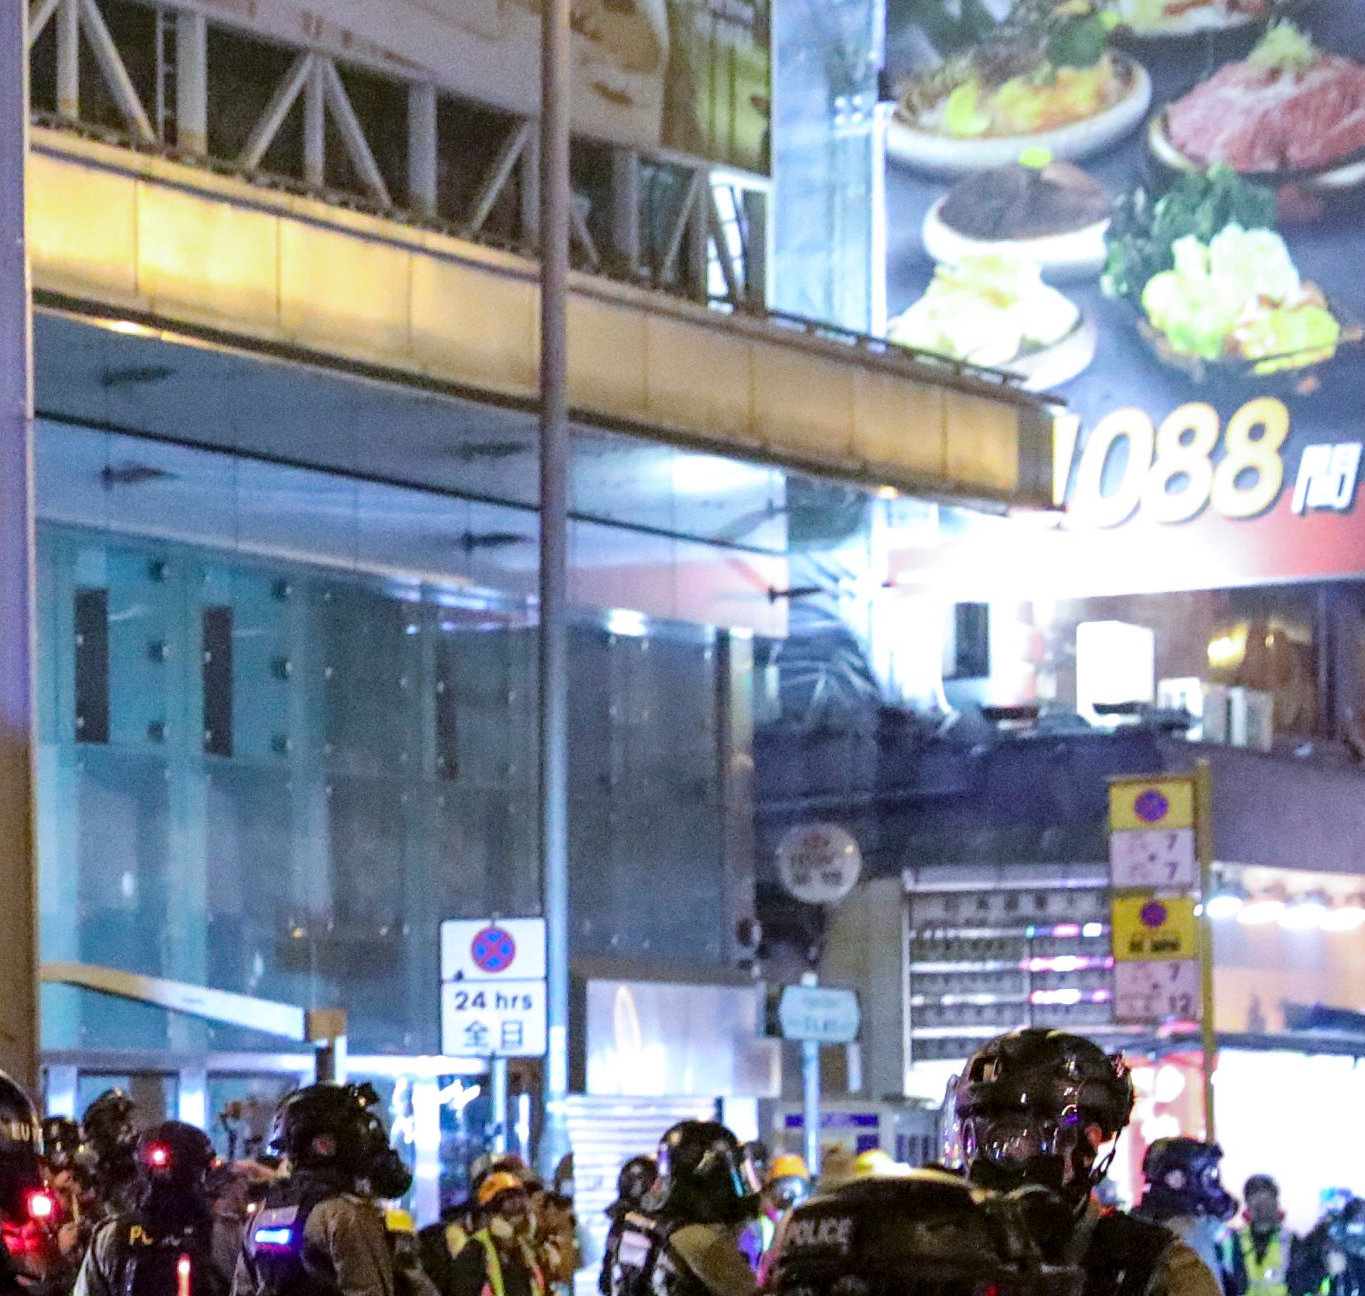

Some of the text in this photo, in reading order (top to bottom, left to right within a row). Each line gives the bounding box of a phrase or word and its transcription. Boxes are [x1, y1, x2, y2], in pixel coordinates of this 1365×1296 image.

[454, 990, 533, 1012] 24 hrs
[463, 1019, 524, 1050] 全日
